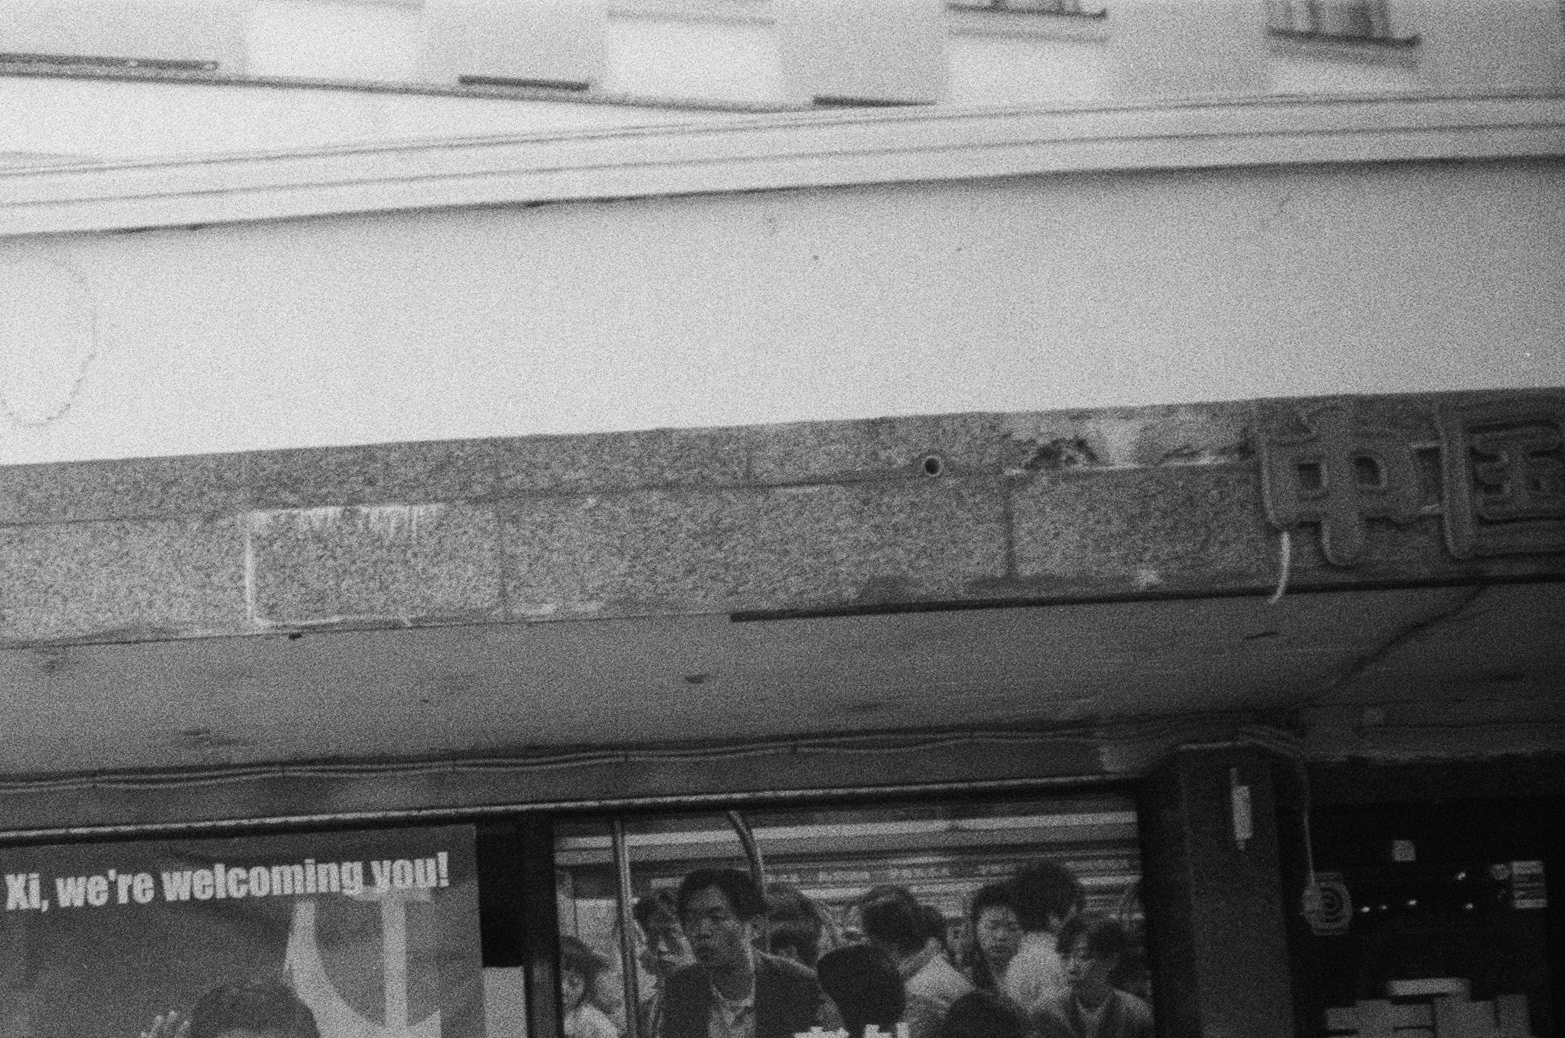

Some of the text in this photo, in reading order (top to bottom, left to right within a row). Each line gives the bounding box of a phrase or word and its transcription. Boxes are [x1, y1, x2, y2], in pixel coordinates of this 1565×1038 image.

[5, 851, 449, 912] Xi, we're welcoming you!
